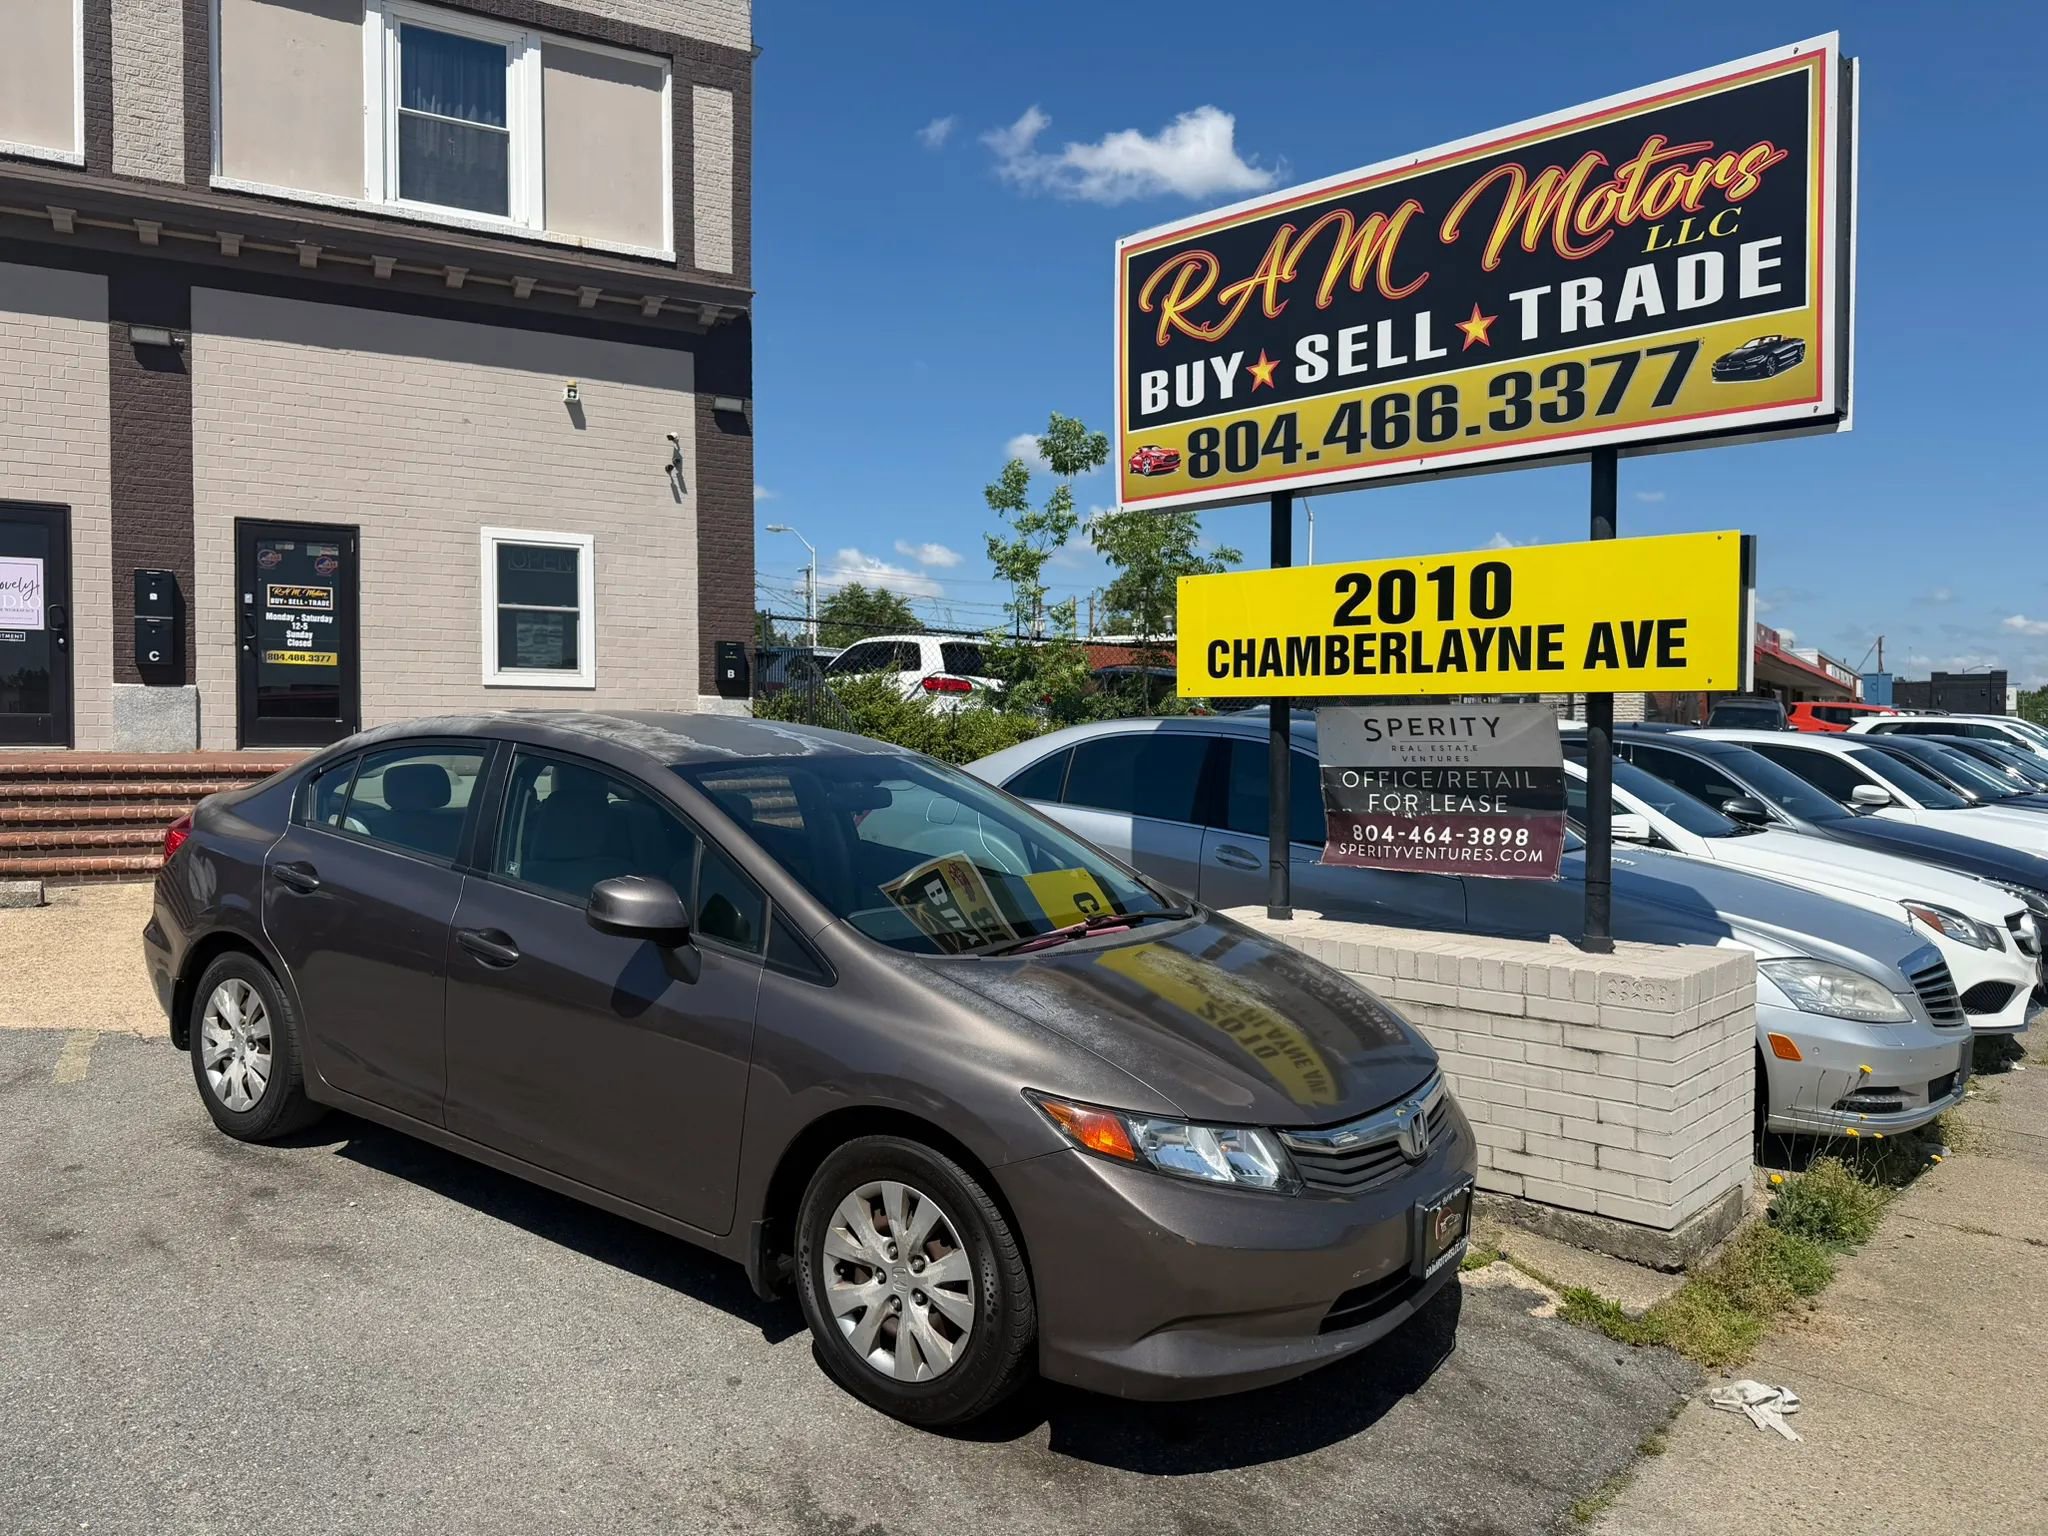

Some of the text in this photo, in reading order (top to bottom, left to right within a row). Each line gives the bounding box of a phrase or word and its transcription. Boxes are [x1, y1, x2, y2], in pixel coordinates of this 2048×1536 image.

[1641, 206, 1742, 253] LLC
[1138, 134, 1788, 346] RAM Motors
[1140, 235, 1783, 416] BUY SELL TRADE
[1187, 339, 1702, 479] 804.466.3377
[309, 599, 330, 607] TRADE
[1333, 561, 1512, 627] 2010
[265, 612, 295, 622] Monday
[301, 613, 333, 624] Saturday
[292, 622, 308, 630] 12-5
[286, 630, 313, 640] Sunday
[287, 639, 312, 647] Closed
[148, 650, 160, 661] C
[1207, 618, 1688, 679] CHAMBERLAYNE AVE
[727, 669, 735, 678] B
[1363, 716, 1500, 742] SPERITY
[1431, 744, 1478, 752] ESTATE
[1342, 770, 1537, 789] OFFICE/RETAIL
[1368, 794, 1508, 813] FOR LEASE
[1352, 824, 1529, 846] 804-464-3898
[1338, 843, 1543, 863] SPERITYVENTURES.COM
